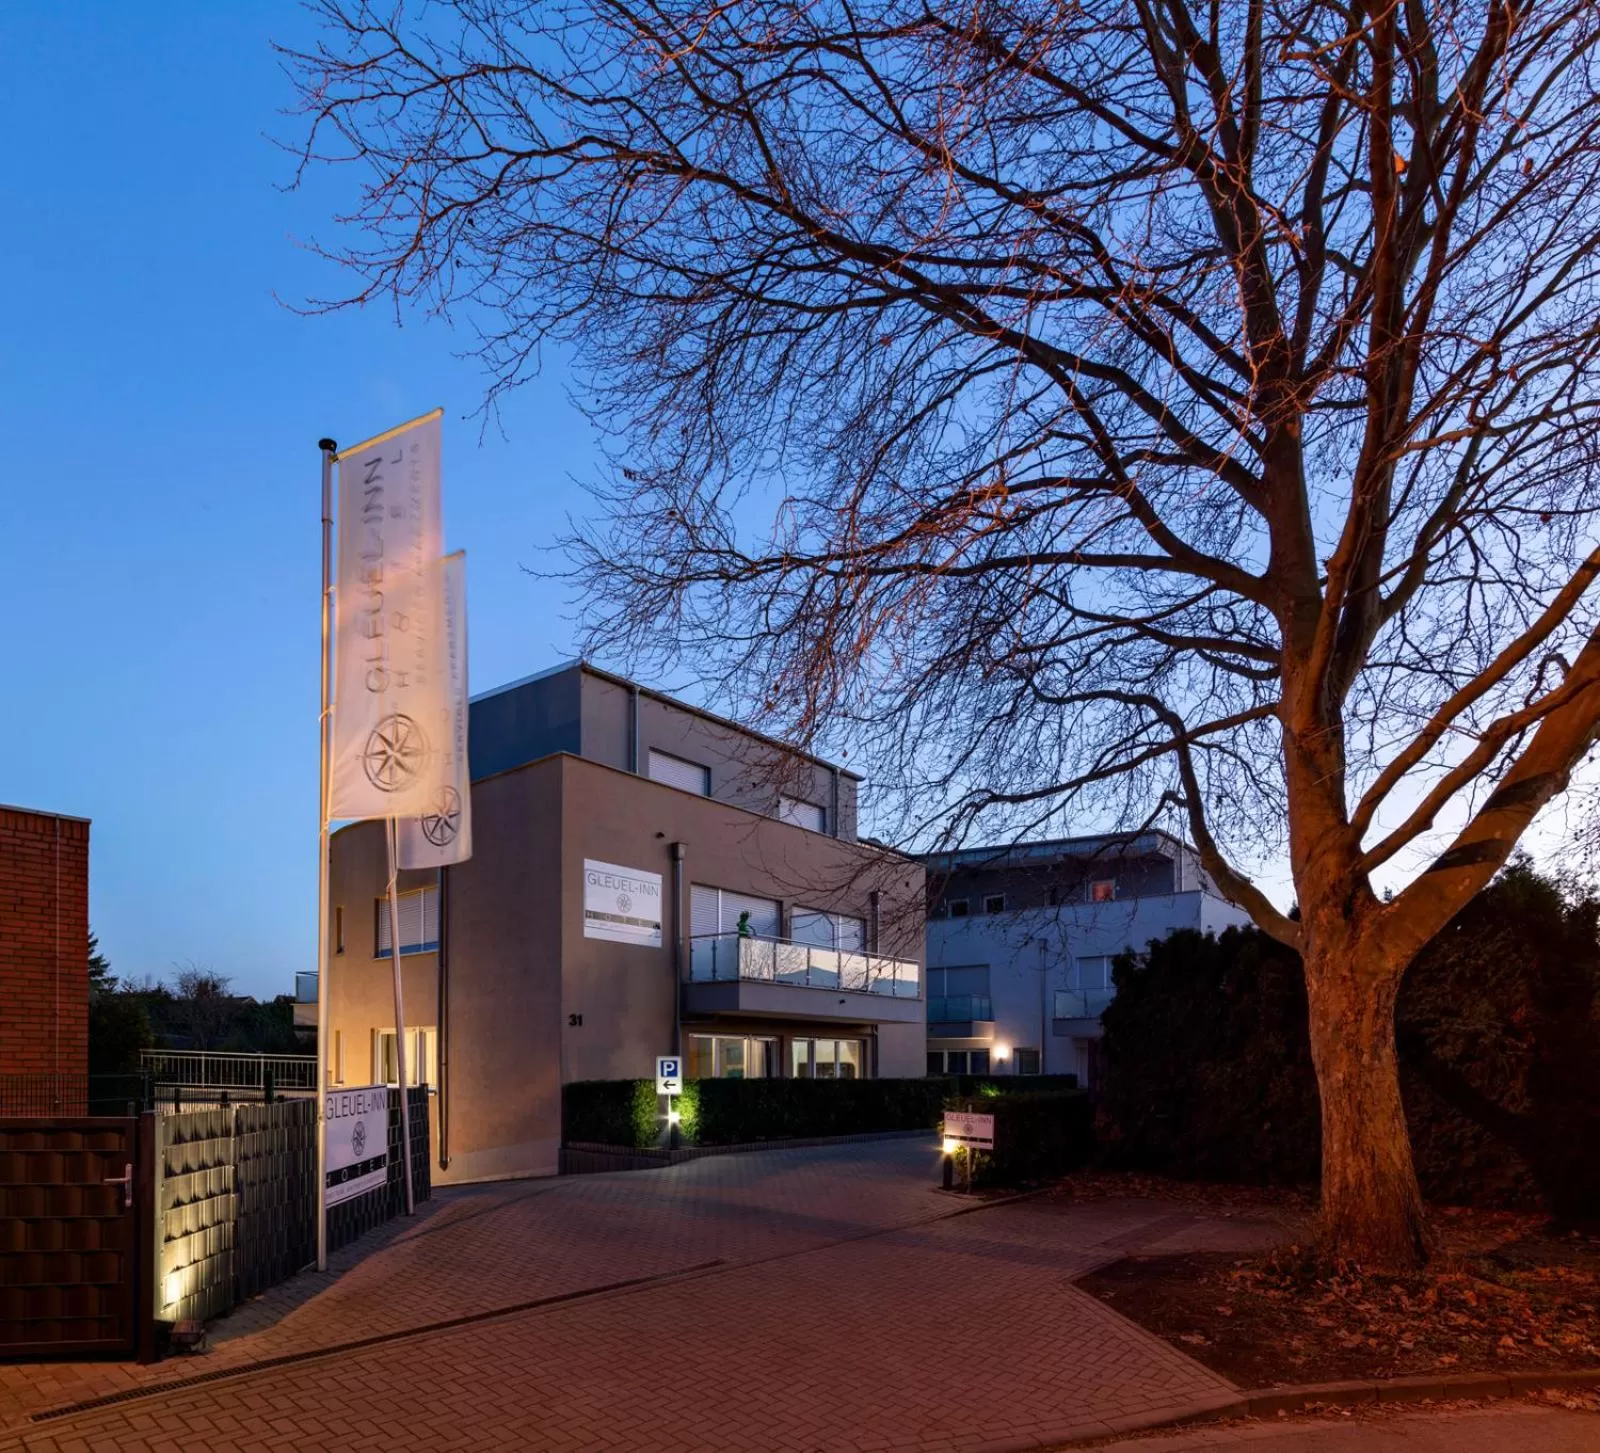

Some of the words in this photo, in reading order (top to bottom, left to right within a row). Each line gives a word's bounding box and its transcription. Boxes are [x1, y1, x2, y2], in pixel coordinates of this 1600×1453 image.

[587, 872, 660, 897] GLEUEL-INN
[568, 1013, 582, 1027] 31
[663, 1061, 675, 1077] P
[326, 1092, 385, 1119] GLEUEL-INN
